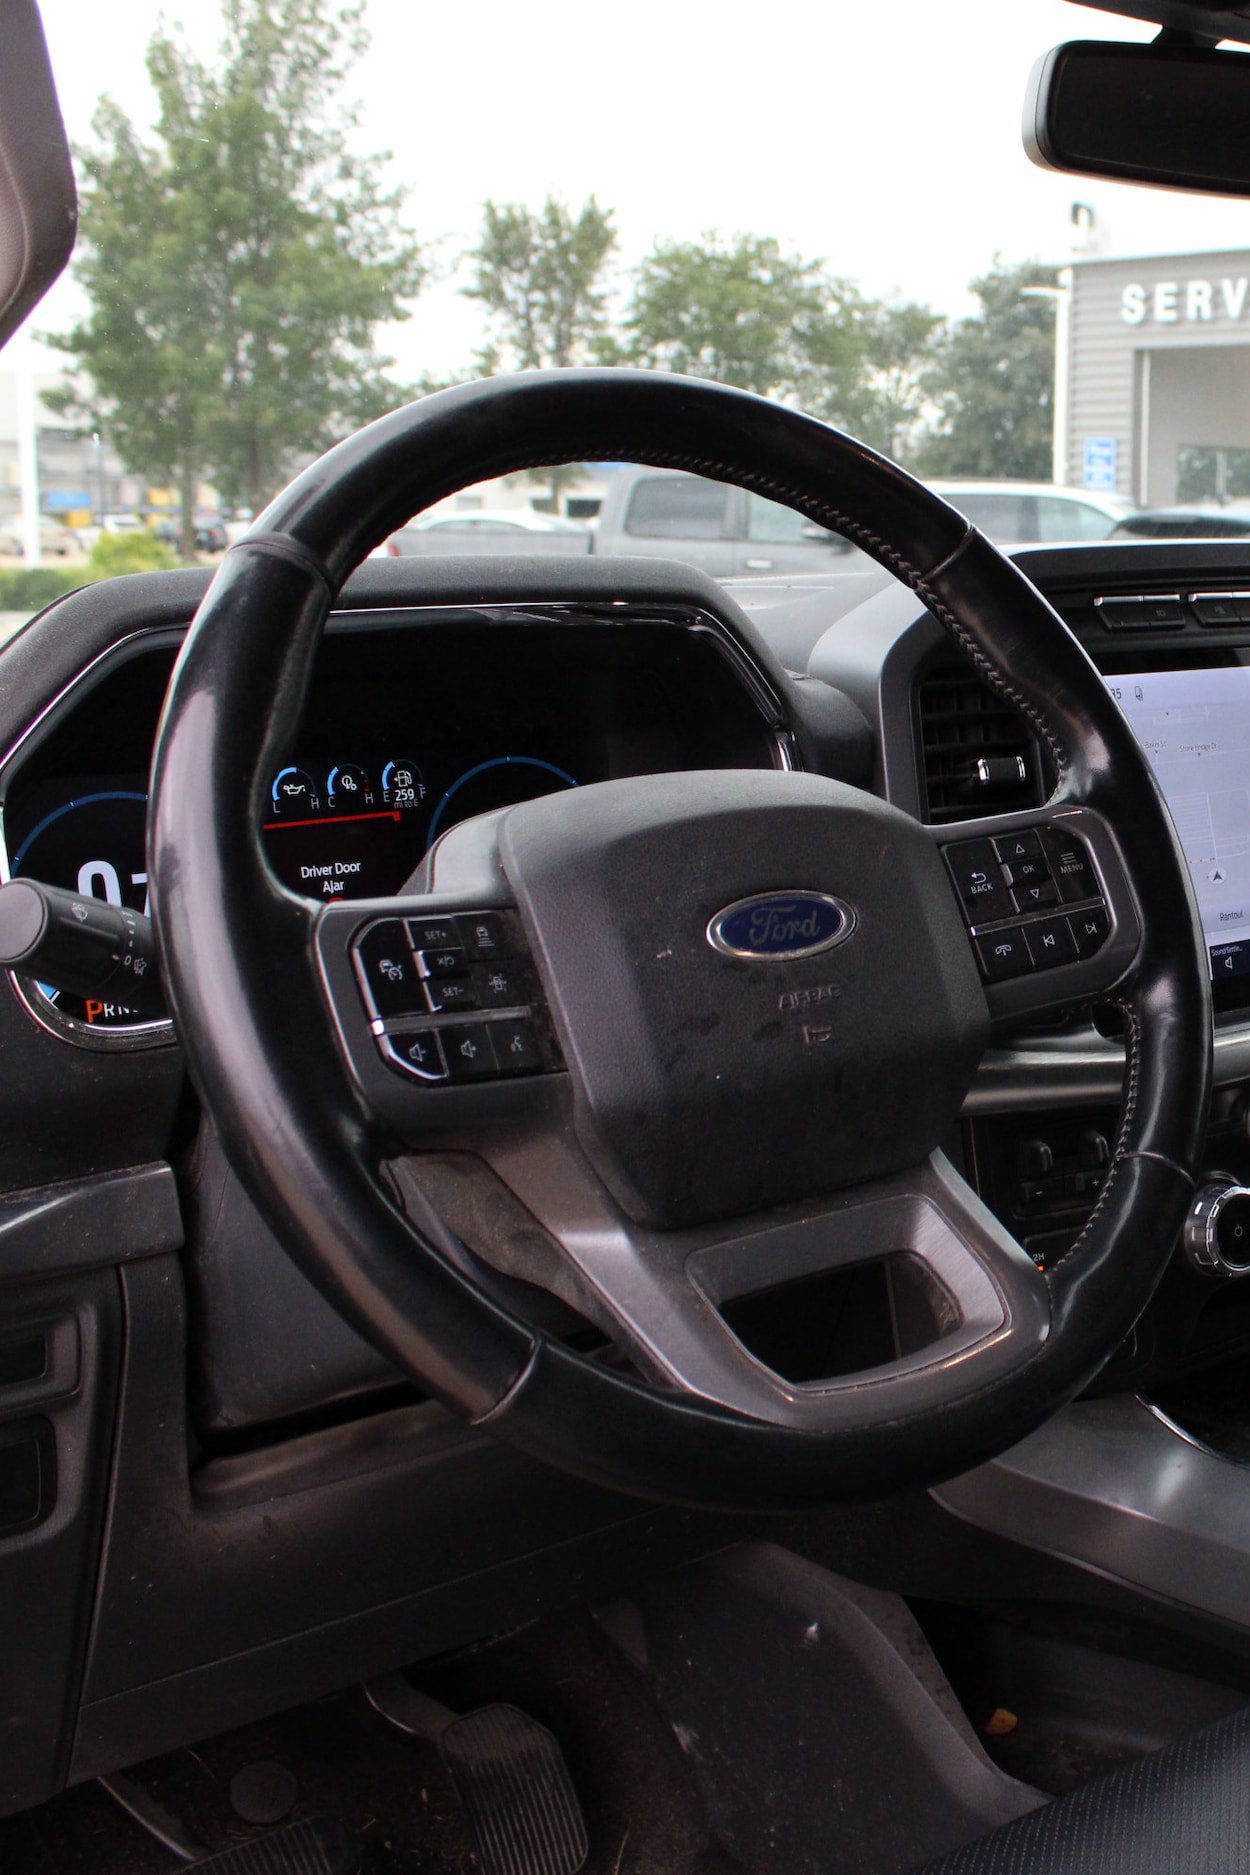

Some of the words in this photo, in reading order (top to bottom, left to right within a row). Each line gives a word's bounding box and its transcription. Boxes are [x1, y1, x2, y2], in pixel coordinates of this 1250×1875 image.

[394, 788, 415, 802] 259
[301, 864, 332, 878] Driver
[334, 862, 361, 875] Door
[1022, 864, 1034, 874] OK
[1060, 863, 1084, 874] MENU
[322, 880, 345, 894] Ajar
[970, 883, 994, 894] BACK
[1220, 910, 1244, 920] Rantoul
[748, 904, 821, 945] Ford
[1032, 1252, 1045, 1262] 2H
